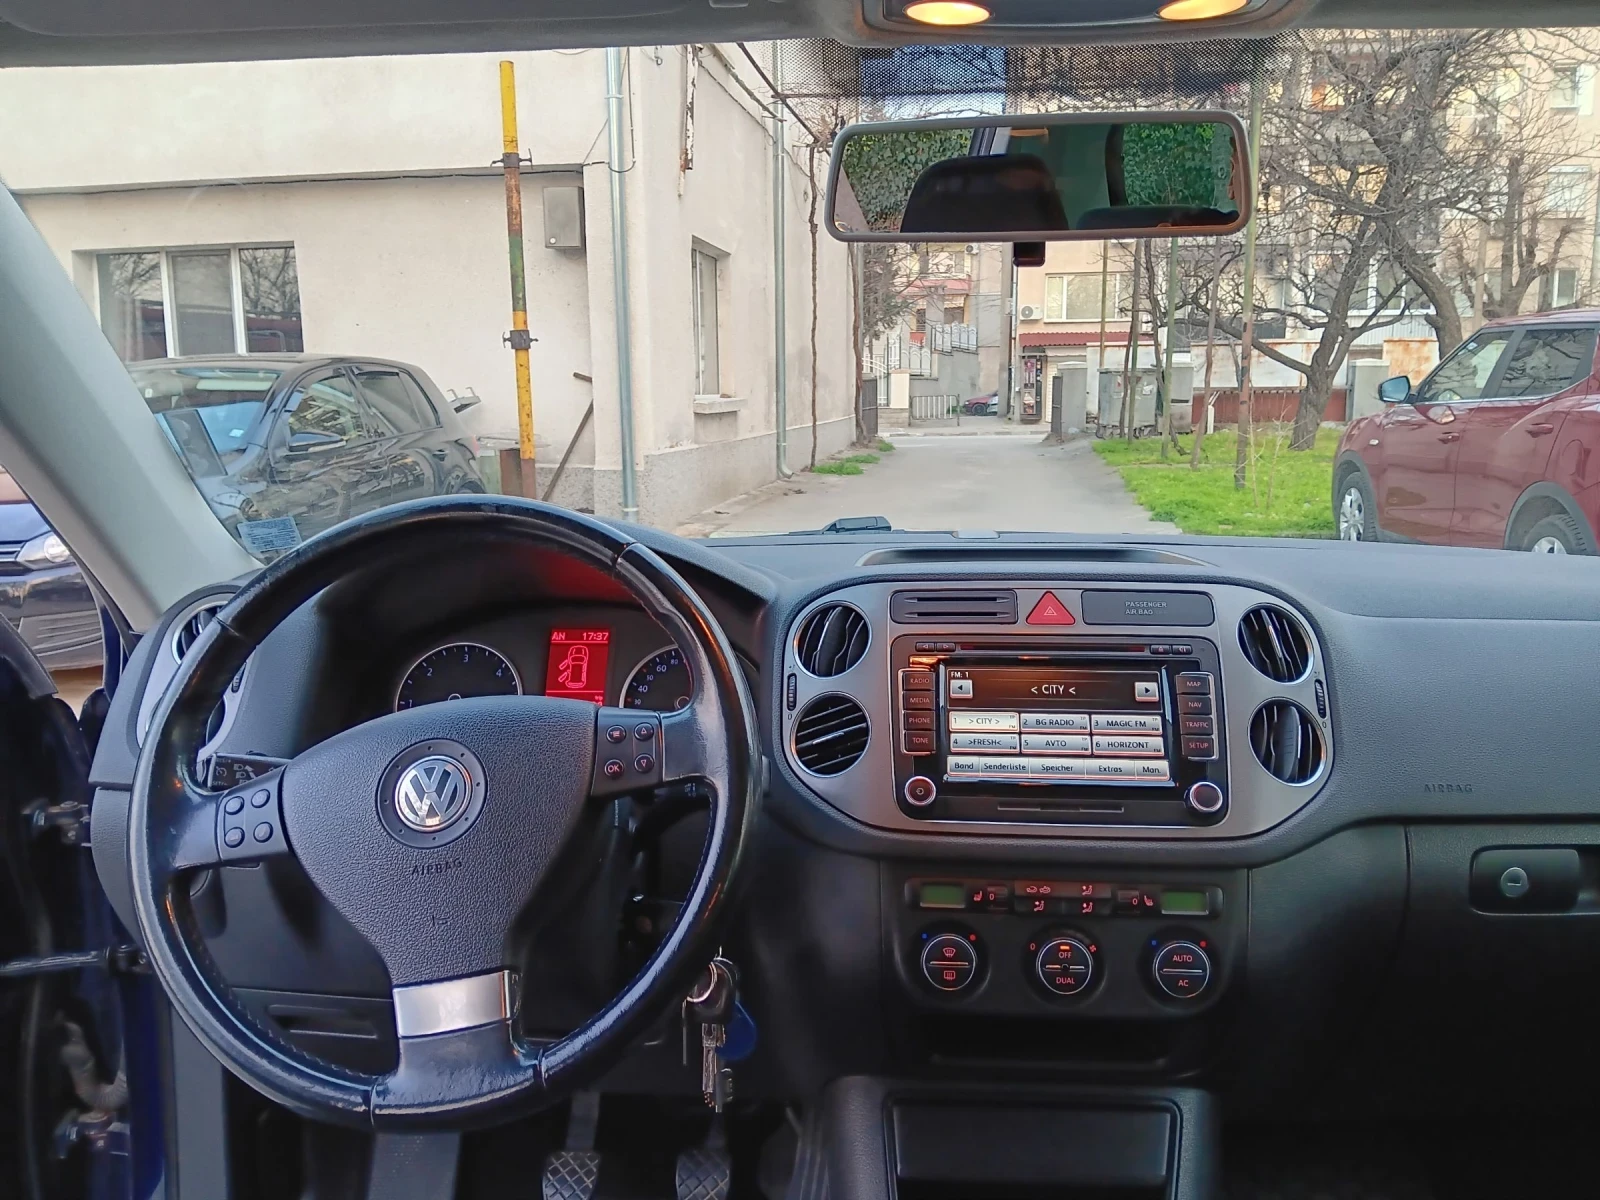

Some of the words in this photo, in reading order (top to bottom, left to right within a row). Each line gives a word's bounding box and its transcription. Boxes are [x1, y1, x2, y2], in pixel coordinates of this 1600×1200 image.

[552, 632, 566, 641] AN
[583, 632, 609, 641] 17:37
[464, 654, 469, 662] 3
[427, 668, 434, 676] 2
[496, 670, 502, 678] 4
[1041, 684, 1065, 695] CITY
[608, 764, 620, 772] OK
[984, 763, 1027, 771] Senderliste
[1041, 764, 1074, 772] Speicher
[1098, 765, 1122, 773] Extras
[1424, 784, 1473, 793] AIRBAG
